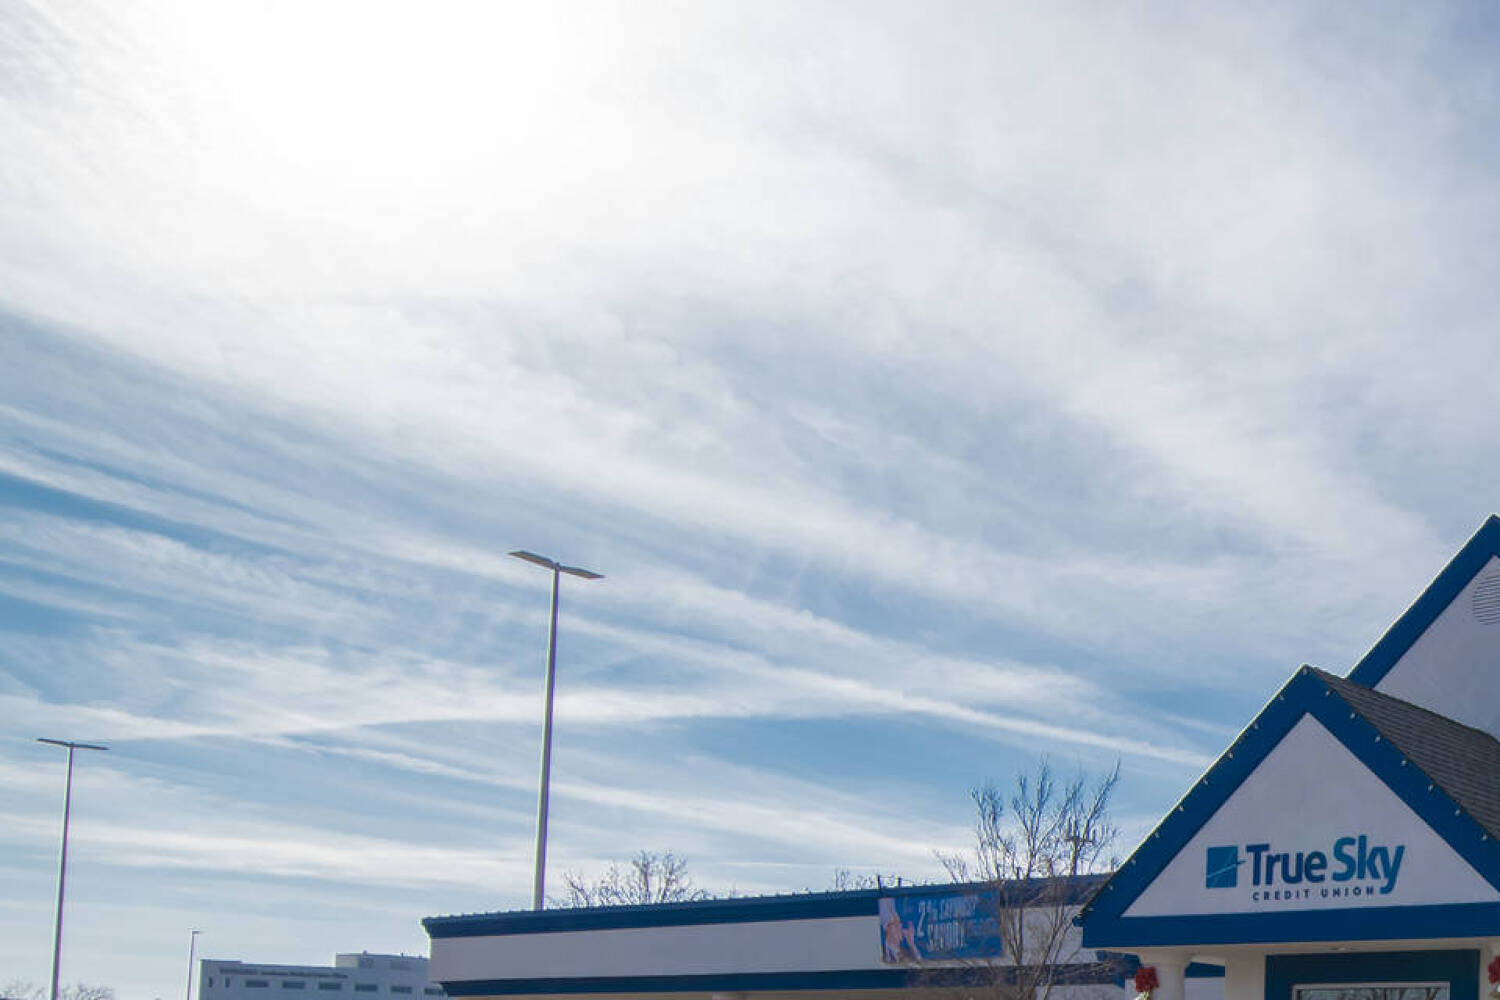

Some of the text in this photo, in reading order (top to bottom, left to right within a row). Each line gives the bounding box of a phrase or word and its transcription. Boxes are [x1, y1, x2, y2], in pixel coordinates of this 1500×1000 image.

[1246, 834, 1406, 895] True Sky
[1252, 885, 1375, 901] CREDIT UNION
